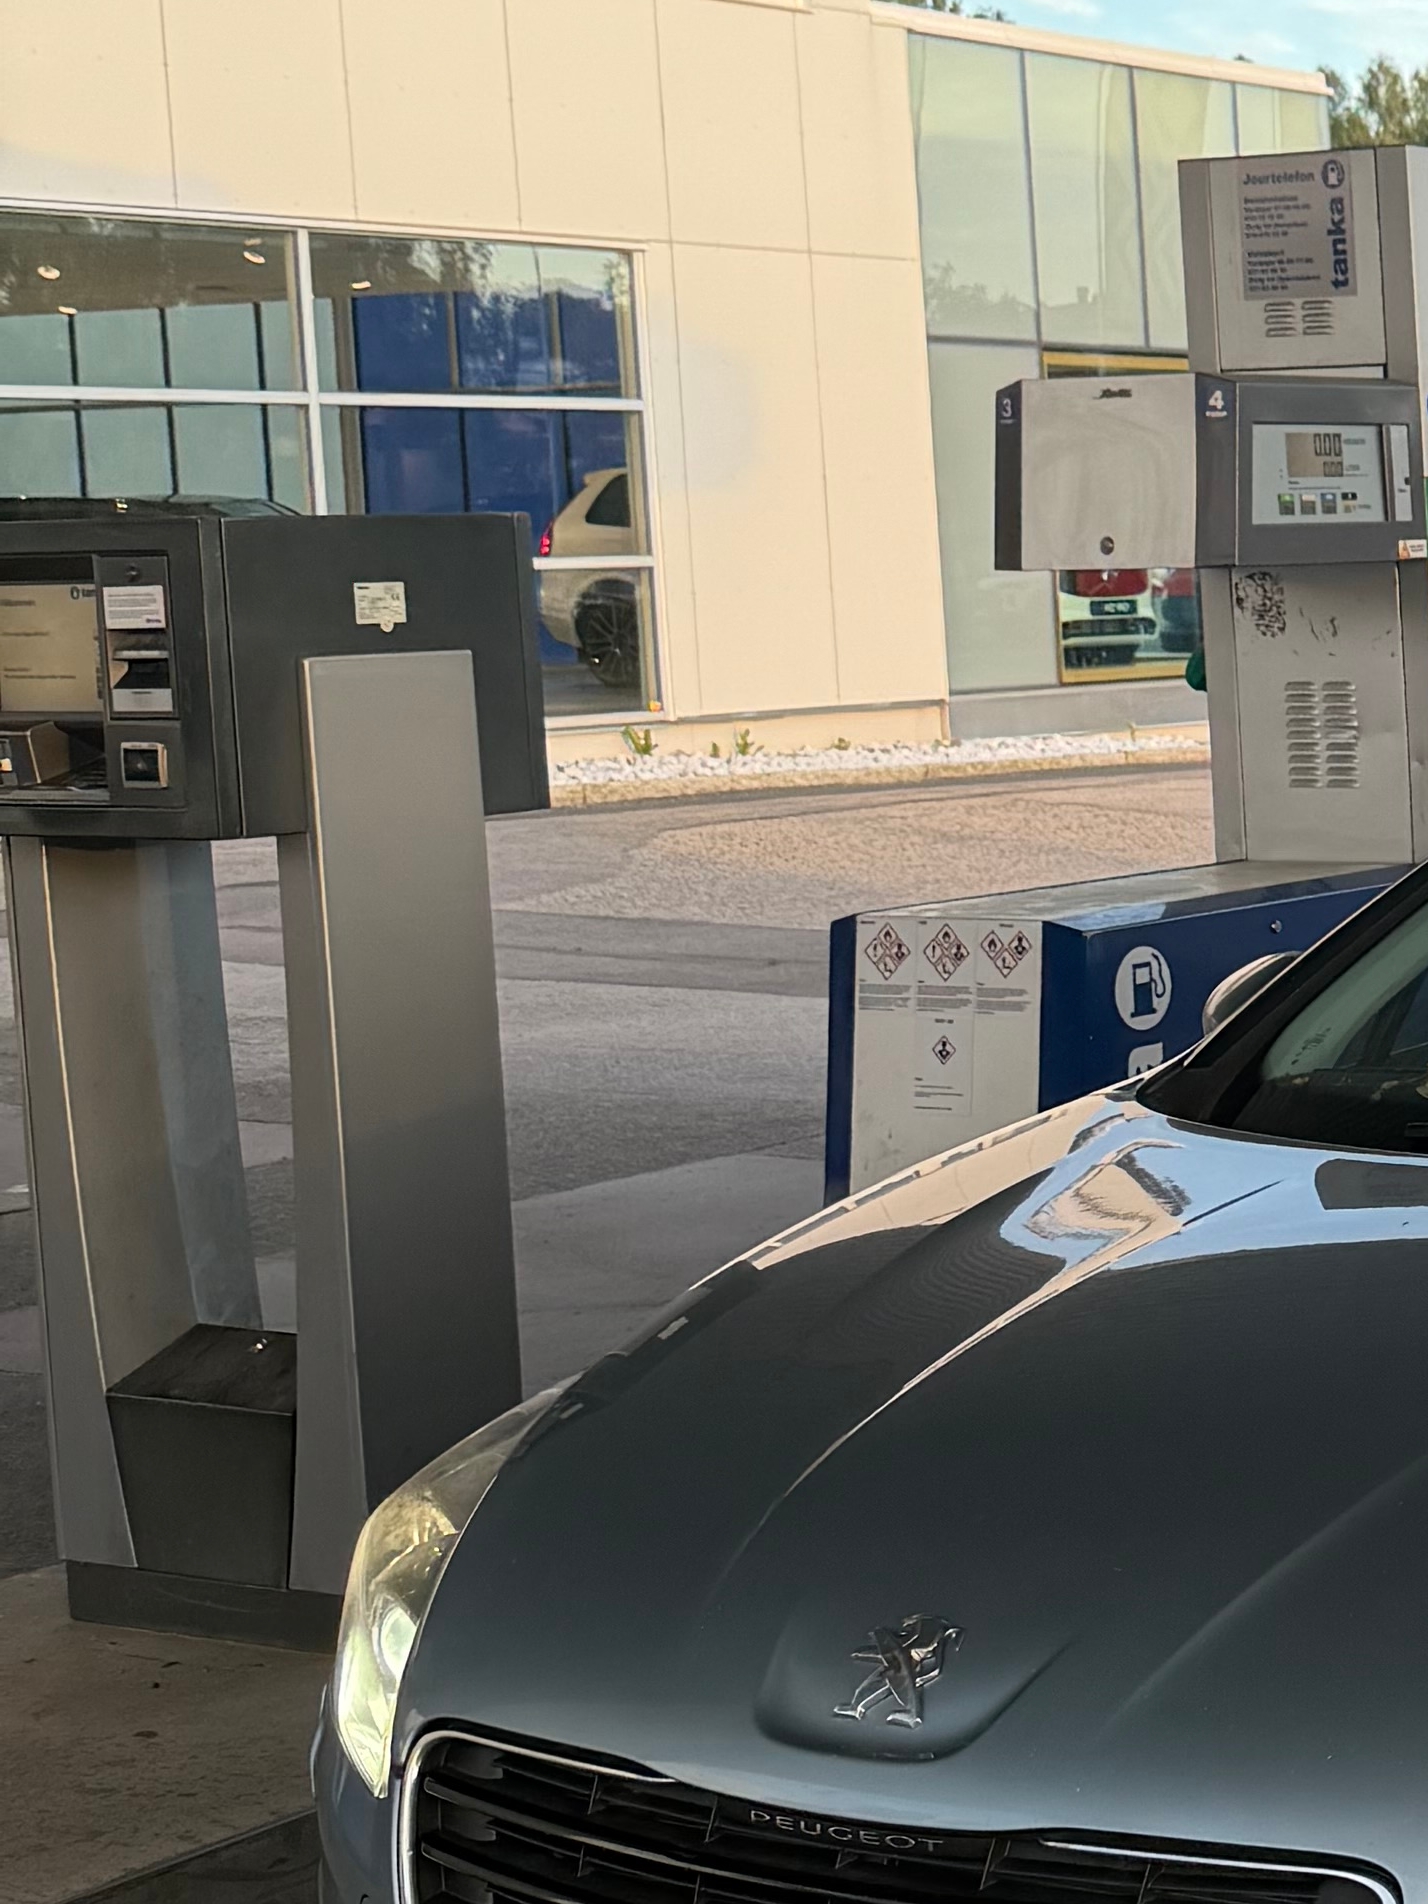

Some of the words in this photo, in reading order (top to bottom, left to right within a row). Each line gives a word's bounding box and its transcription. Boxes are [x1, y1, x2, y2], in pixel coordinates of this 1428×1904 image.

[1242, 170, 1316, 186] Jourtelefon
[1327, 196, 1350, 290] tanka
[1001, 398, 1013, 418] 3
[1208, 389, 1225, 411] 4
[748, 1807, 946, 1855] PEUGEOT
